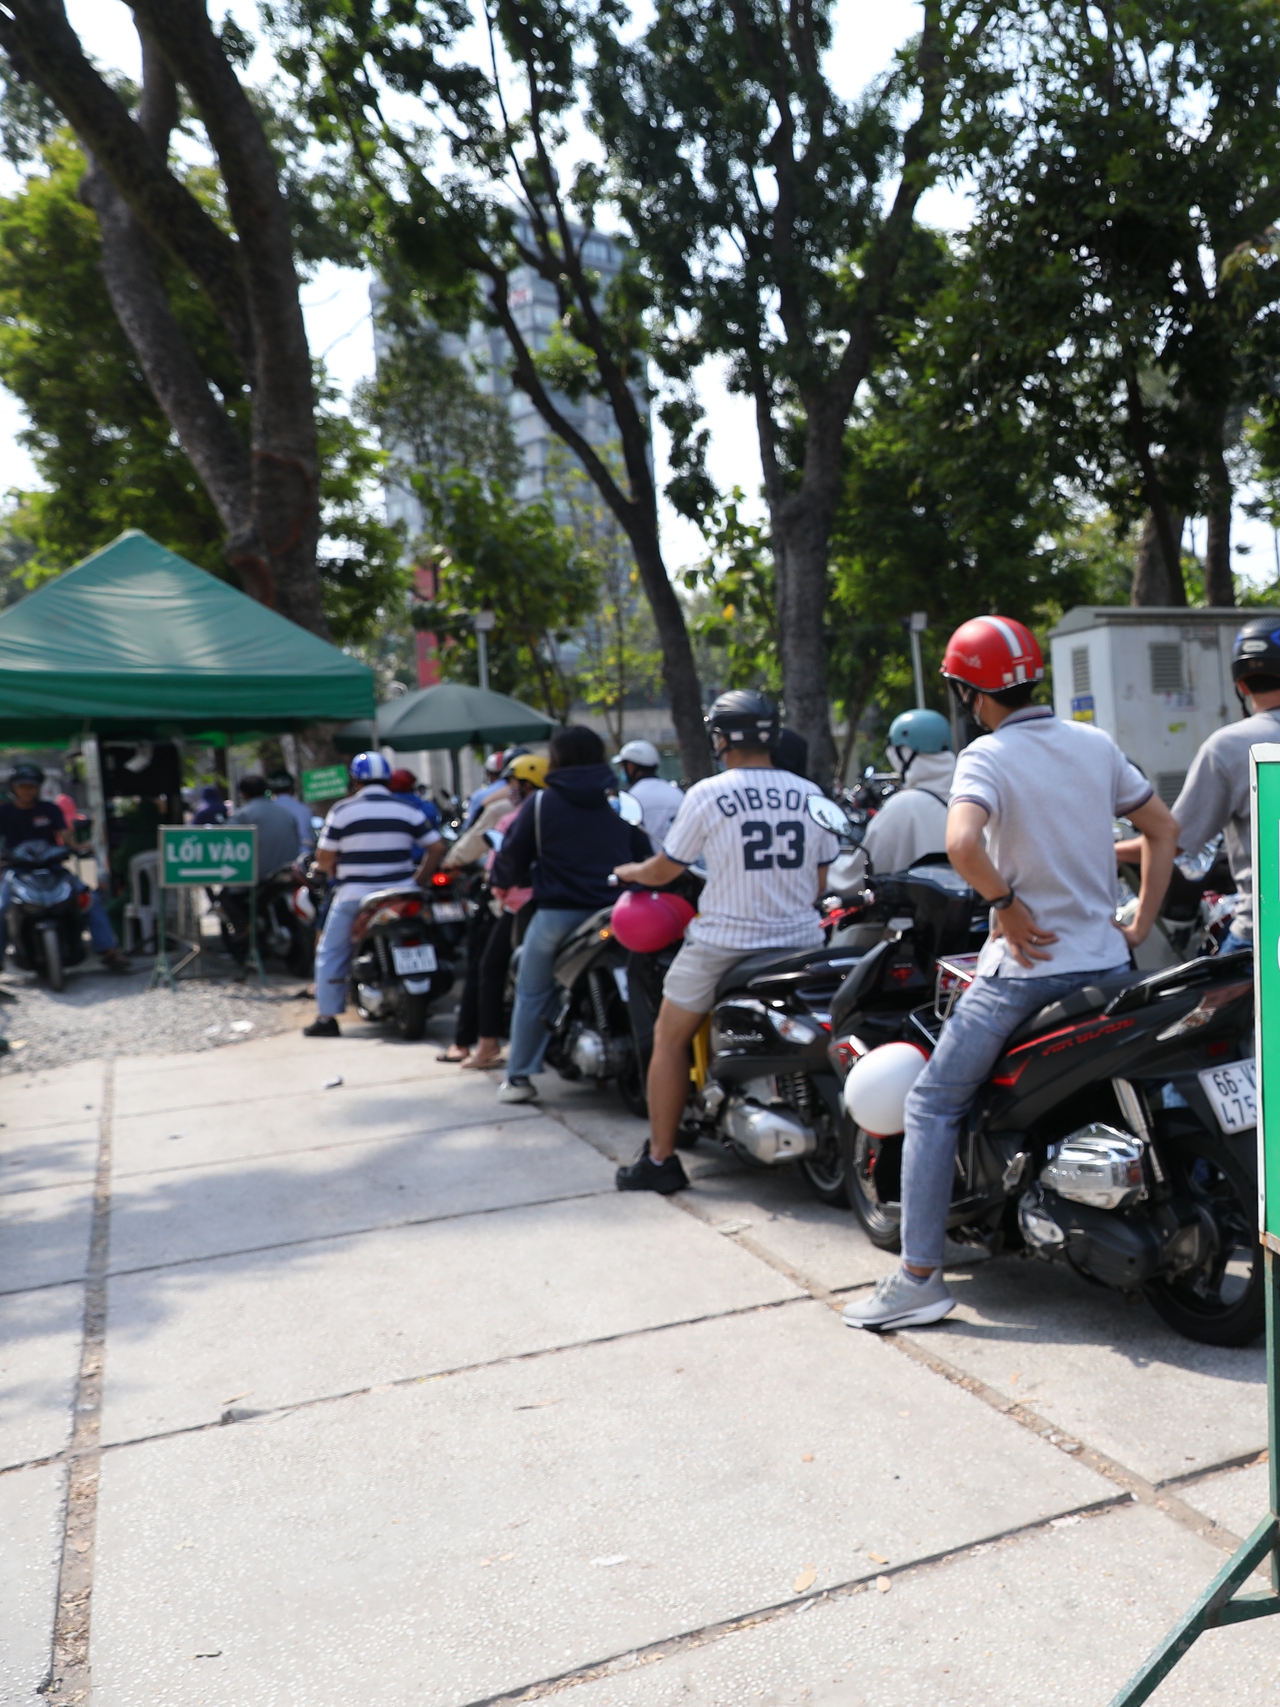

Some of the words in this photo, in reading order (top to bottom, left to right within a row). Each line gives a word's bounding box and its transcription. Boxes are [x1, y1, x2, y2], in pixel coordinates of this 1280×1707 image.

[166, 834, 203, 863] LỐI
[208, 836, 251, 863] VÀO
[741, 820, 805, 870] 23
[1221, 1095, 1257, 1127] 475
